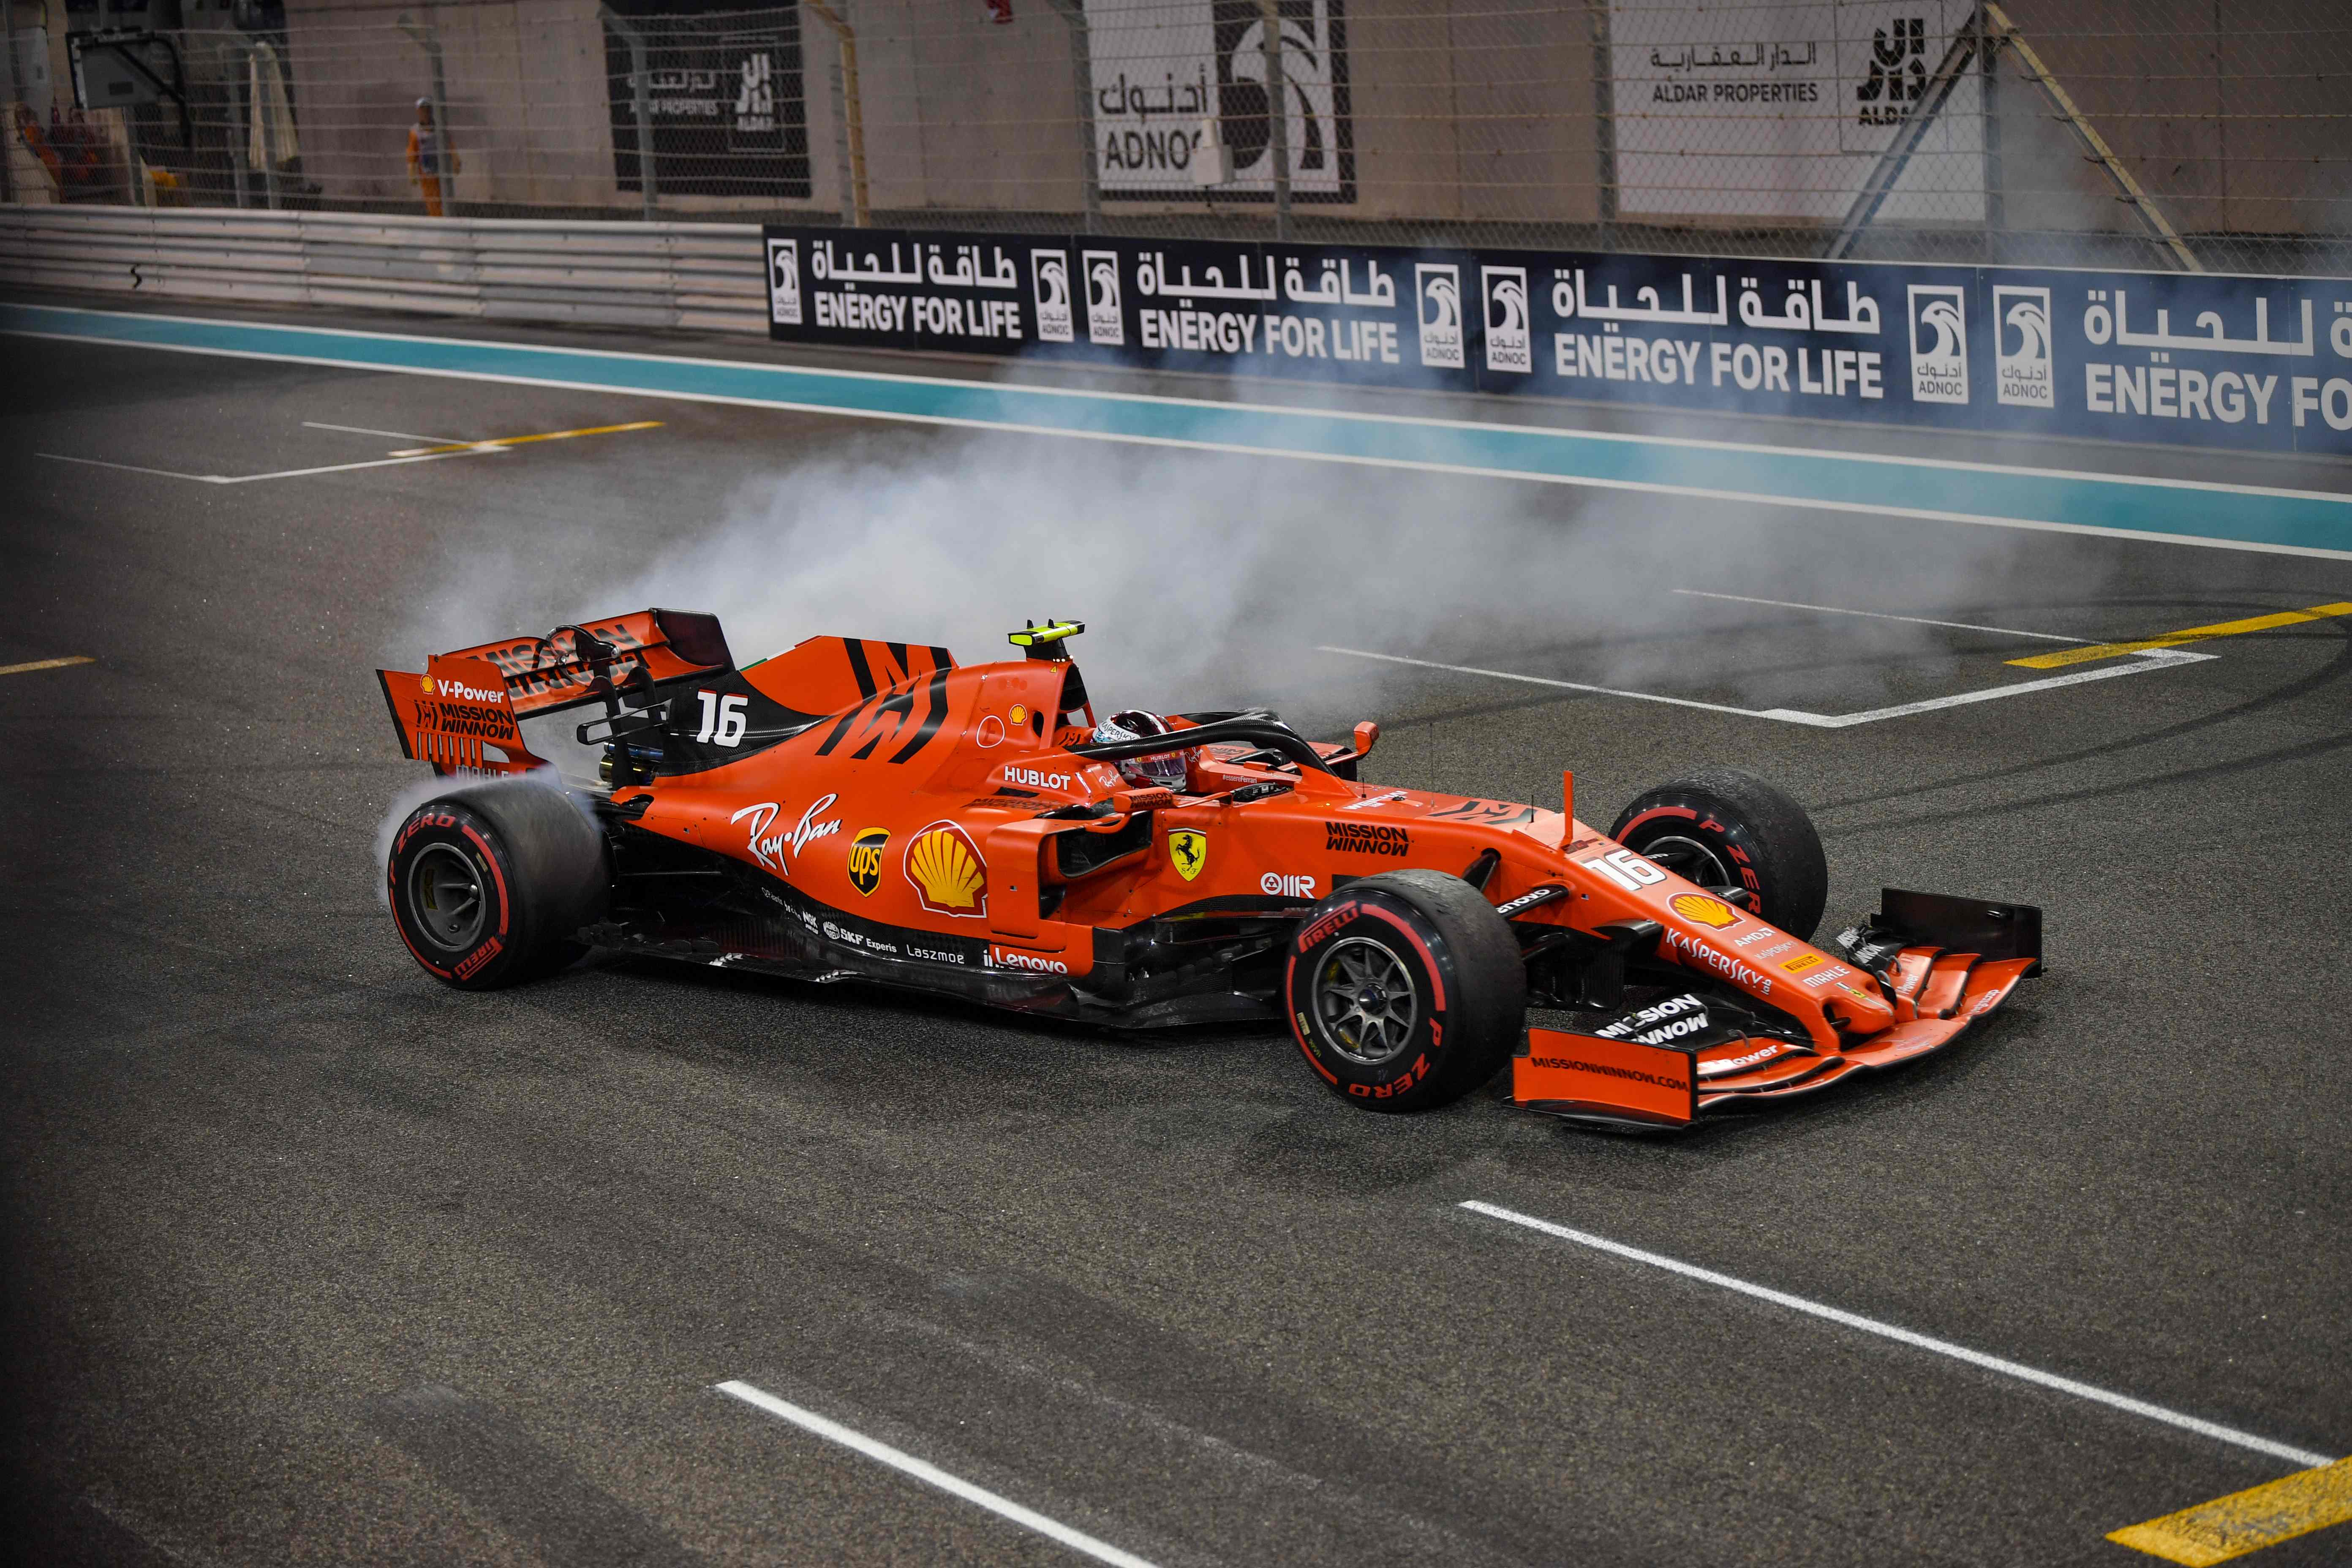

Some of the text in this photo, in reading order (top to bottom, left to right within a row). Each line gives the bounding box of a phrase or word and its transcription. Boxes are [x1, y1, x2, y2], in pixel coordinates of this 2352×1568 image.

[1652, 84, 1818, 103] ALDAR PROPERTIES
[1859, 106, 1910, 125] ALDA
[812, 240, 1018, 292] طاقة للحياة
[1136, 252, 1395, 308] طاقة للحياة
[814, 291, 1023, 338] ENERGY FOR LIFE
[1552, 269, 1880, 334] طاقة للحياة
[1140, 309, 1400, 364] ENERGY FOR LIFE
[2083, 290, 2314, 363] للحياة
[1426, 347, 1460, 362] ADNOC
[1491, 352, 1527, 365] ADNOC
[1554, 333, 1884, 399] ENERGY FOR LIFE
[1918, 381, 1963, 396] ADNOC
[2003, 383, 2048, 400] ADNOC
[2086, 363, 2278, 425] ENERGY
[437, 679, 504, 703] V-Power
[438, 702, 514, 725] MISSION
[696, 689, 749, 748] 16
[441, 718, 514, 740] WINNOW
[1004, 765, 1071, 791] HUBLOT
[1222, 774, 1257, 784] #essereFerrari
[397, 813, 456, 854] ZERO
[1326, 822, 1409, 842] MISSION
[1326, 836, 1409, 857] WINNOW
[1580, 847, 1667, 891] 16
[1699, 819, 1761, 914] P ZER
[1495, 889, 1550, 913] enovo
[803, 911, 818, 928] NGK
[1298, 900, 1359, 953] PIRELLI
[840, 928, 864, 945] SKF
[866, 938, 897, 953] Experis
[906, 945, 965, 964] Laszmoe
[1734, 931, 1766, 947] AMD
[995, 947, 1068, 974] Lenovo
[1666, 928, 1764, 988] KASPERSKY
[1784, 956, 1819, 971] PIRELLI
[1802, 966, 1851, 988] MAHLE
[1348, 1018, 1443, 1098] P ZERO
[1531, 1057, 1689, 1092] MISSIONWINNOW.COM
